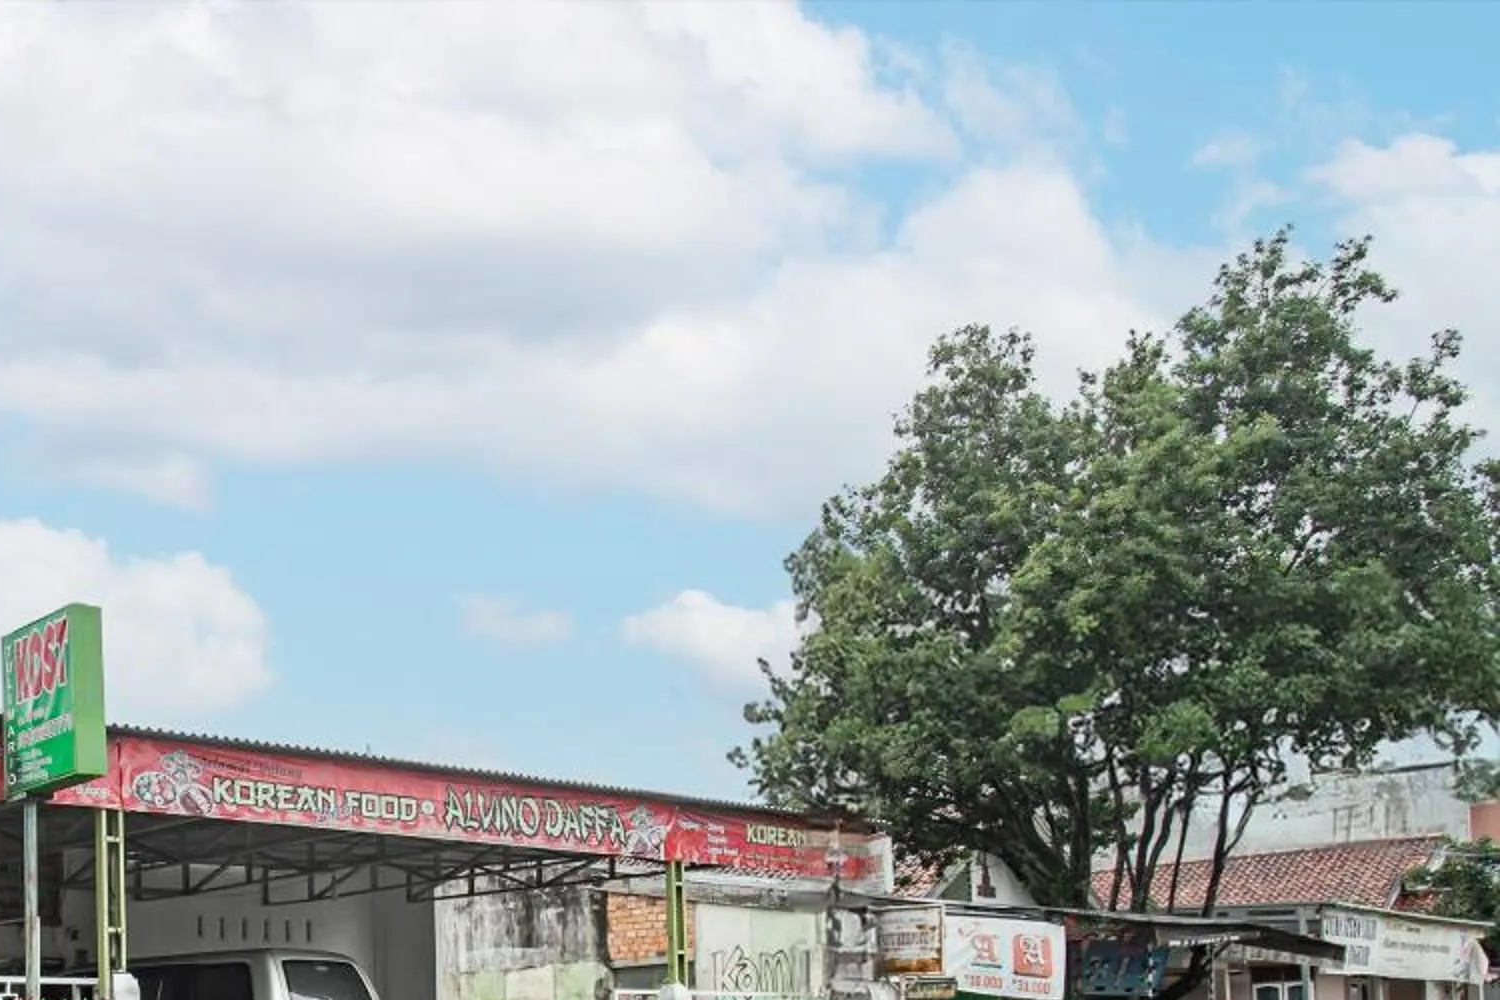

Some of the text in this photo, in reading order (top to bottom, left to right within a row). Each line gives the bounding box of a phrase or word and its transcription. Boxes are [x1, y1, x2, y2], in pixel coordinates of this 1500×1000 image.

[14, 616, 68, 705] KOST
[212, 776, 336, 814] KOREAN
[345, 791, 418, 822] FOOD
[443, 784, 627, 847] ALVINO DAFFA
[746, 823, 807, 848] KOREAN
